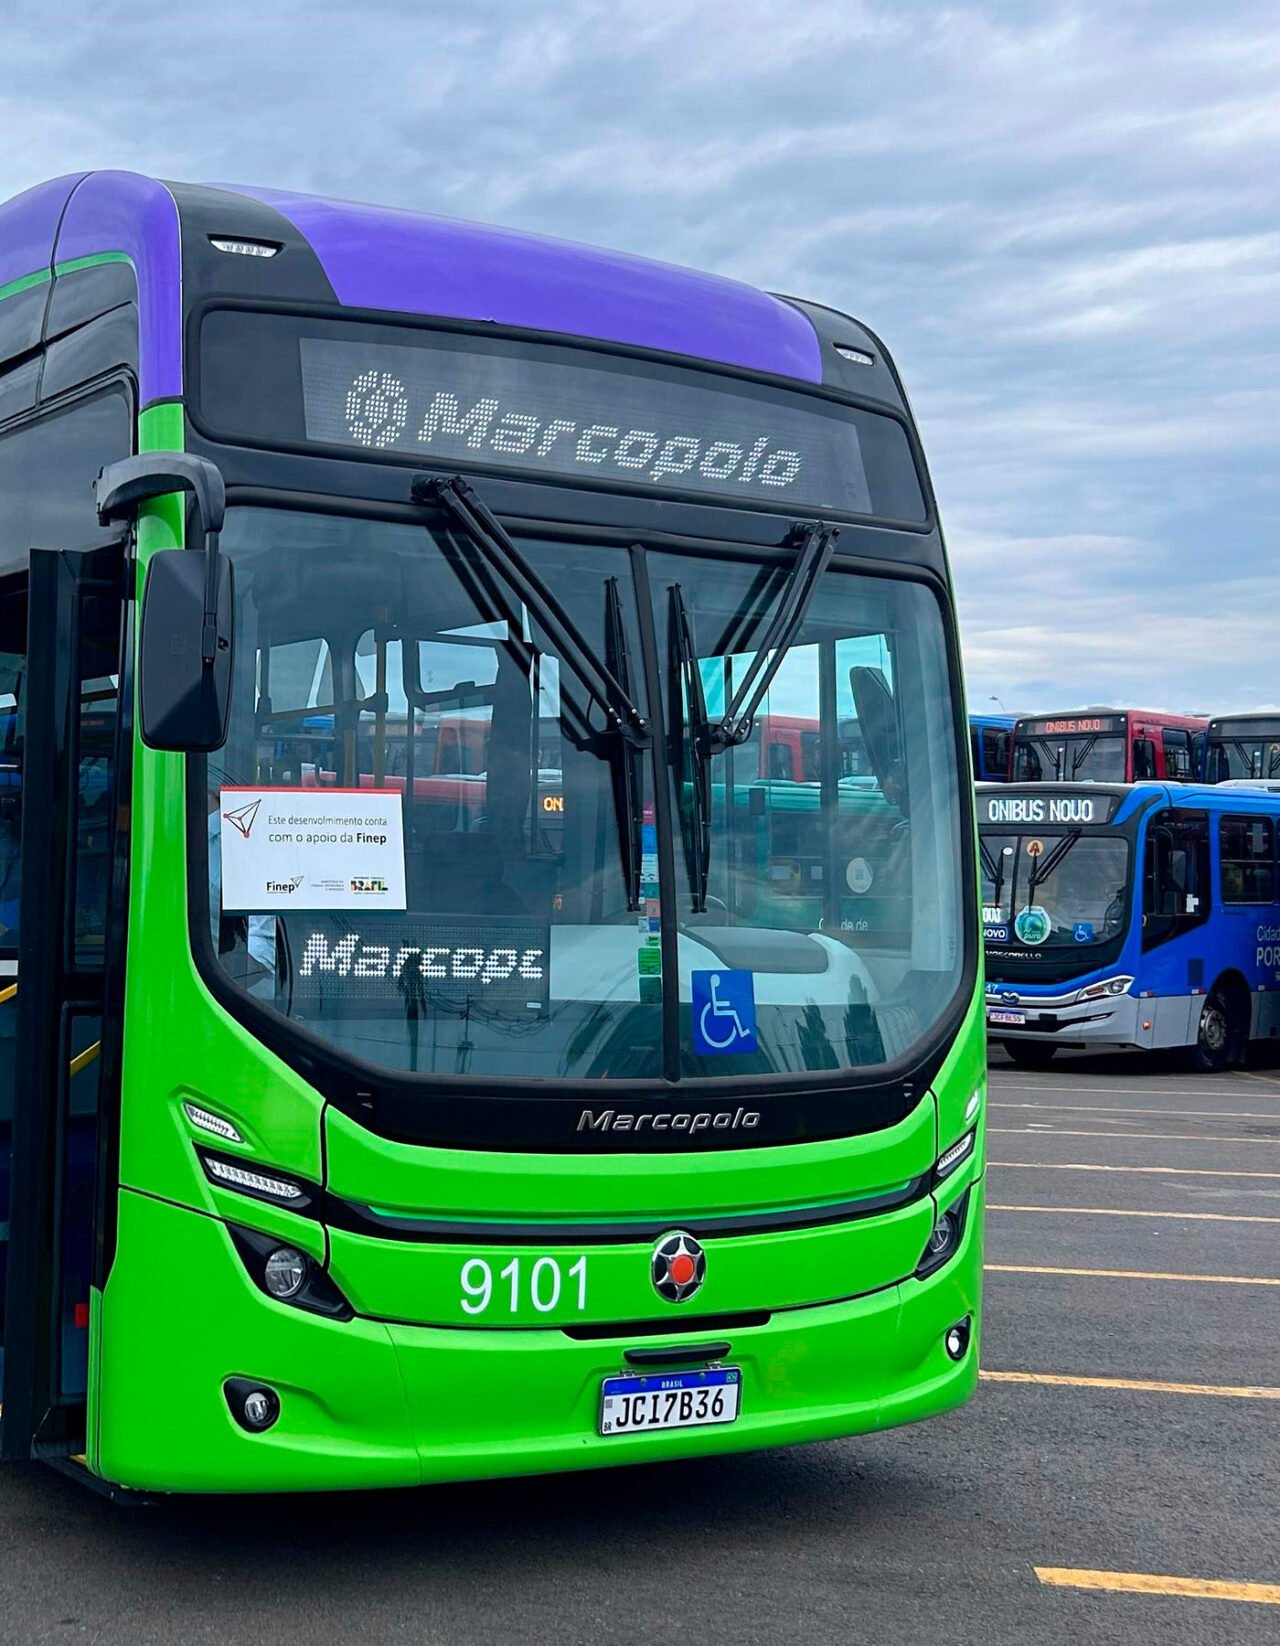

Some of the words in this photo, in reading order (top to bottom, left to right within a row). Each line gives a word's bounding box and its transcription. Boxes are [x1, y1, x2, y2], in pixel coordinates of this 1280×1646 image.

[417, 391, 803, 486] Marcopolo
[268, 815, 286, 825] Este
[288, 815, 363, 826] desenvolmimento
[364, 816, 388, 826] conta
[988, 799, 1044, 821] ONIBUS
[1050, 799, 1093, 822] NOVO
[269, 833, 293, 842] com
[295, 834, 303, 842] o
[306, 832, 338, 847] apoio
[340, 832, 353, 843] da
[356, 832, 387, 846] Finep
[266, 881, 295, 894] Finep
[576, 1107, 761, 1134] Marcopolo
[460, 1255, 587, 1315] 9101
[661, 1379, 684, 1389] BRASIL
[616, 1388, 724, 1427] JCI7B36
